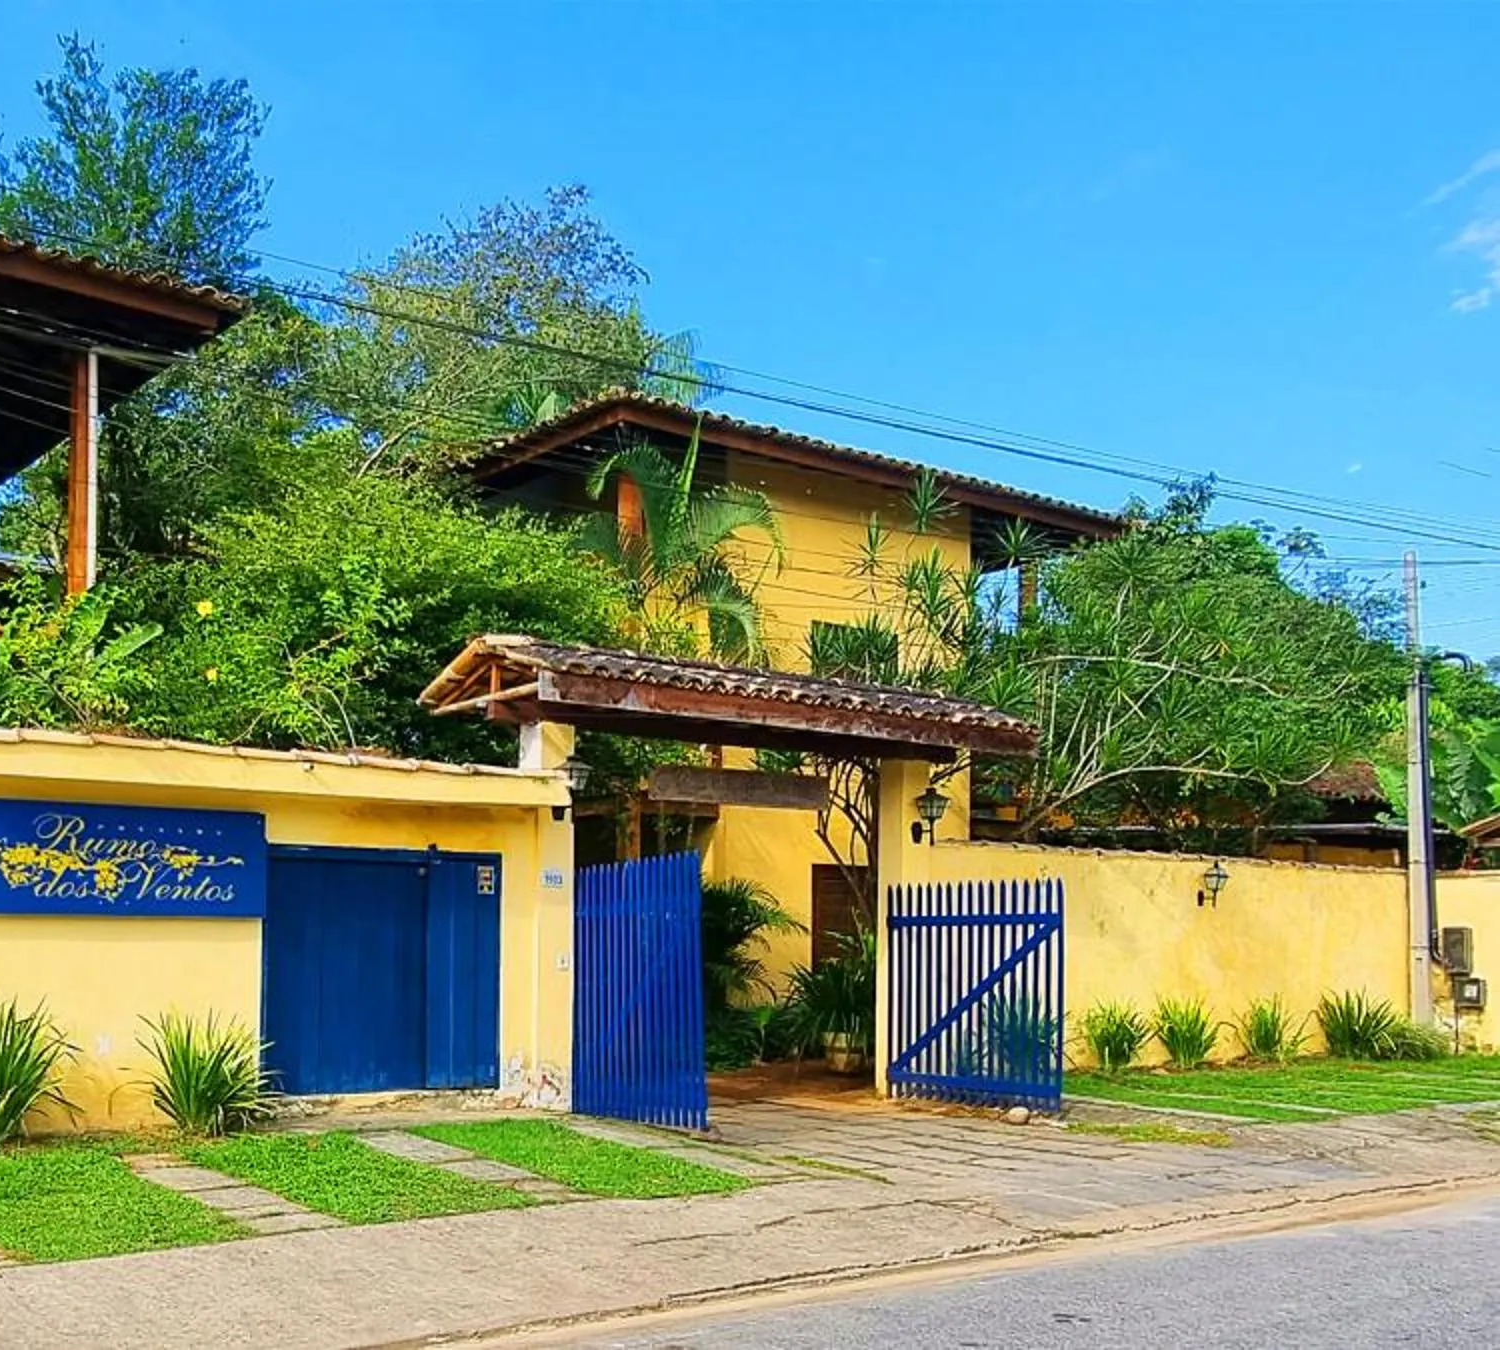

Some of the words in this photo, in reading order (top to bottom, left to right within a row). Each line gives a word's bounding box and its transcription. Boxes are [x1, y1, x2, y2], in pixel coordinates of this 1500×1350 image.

[32, 812, 160, 861] Rumo
[33, 866, 90, 898] dos
[120, 861, 237, 901] Ventos
